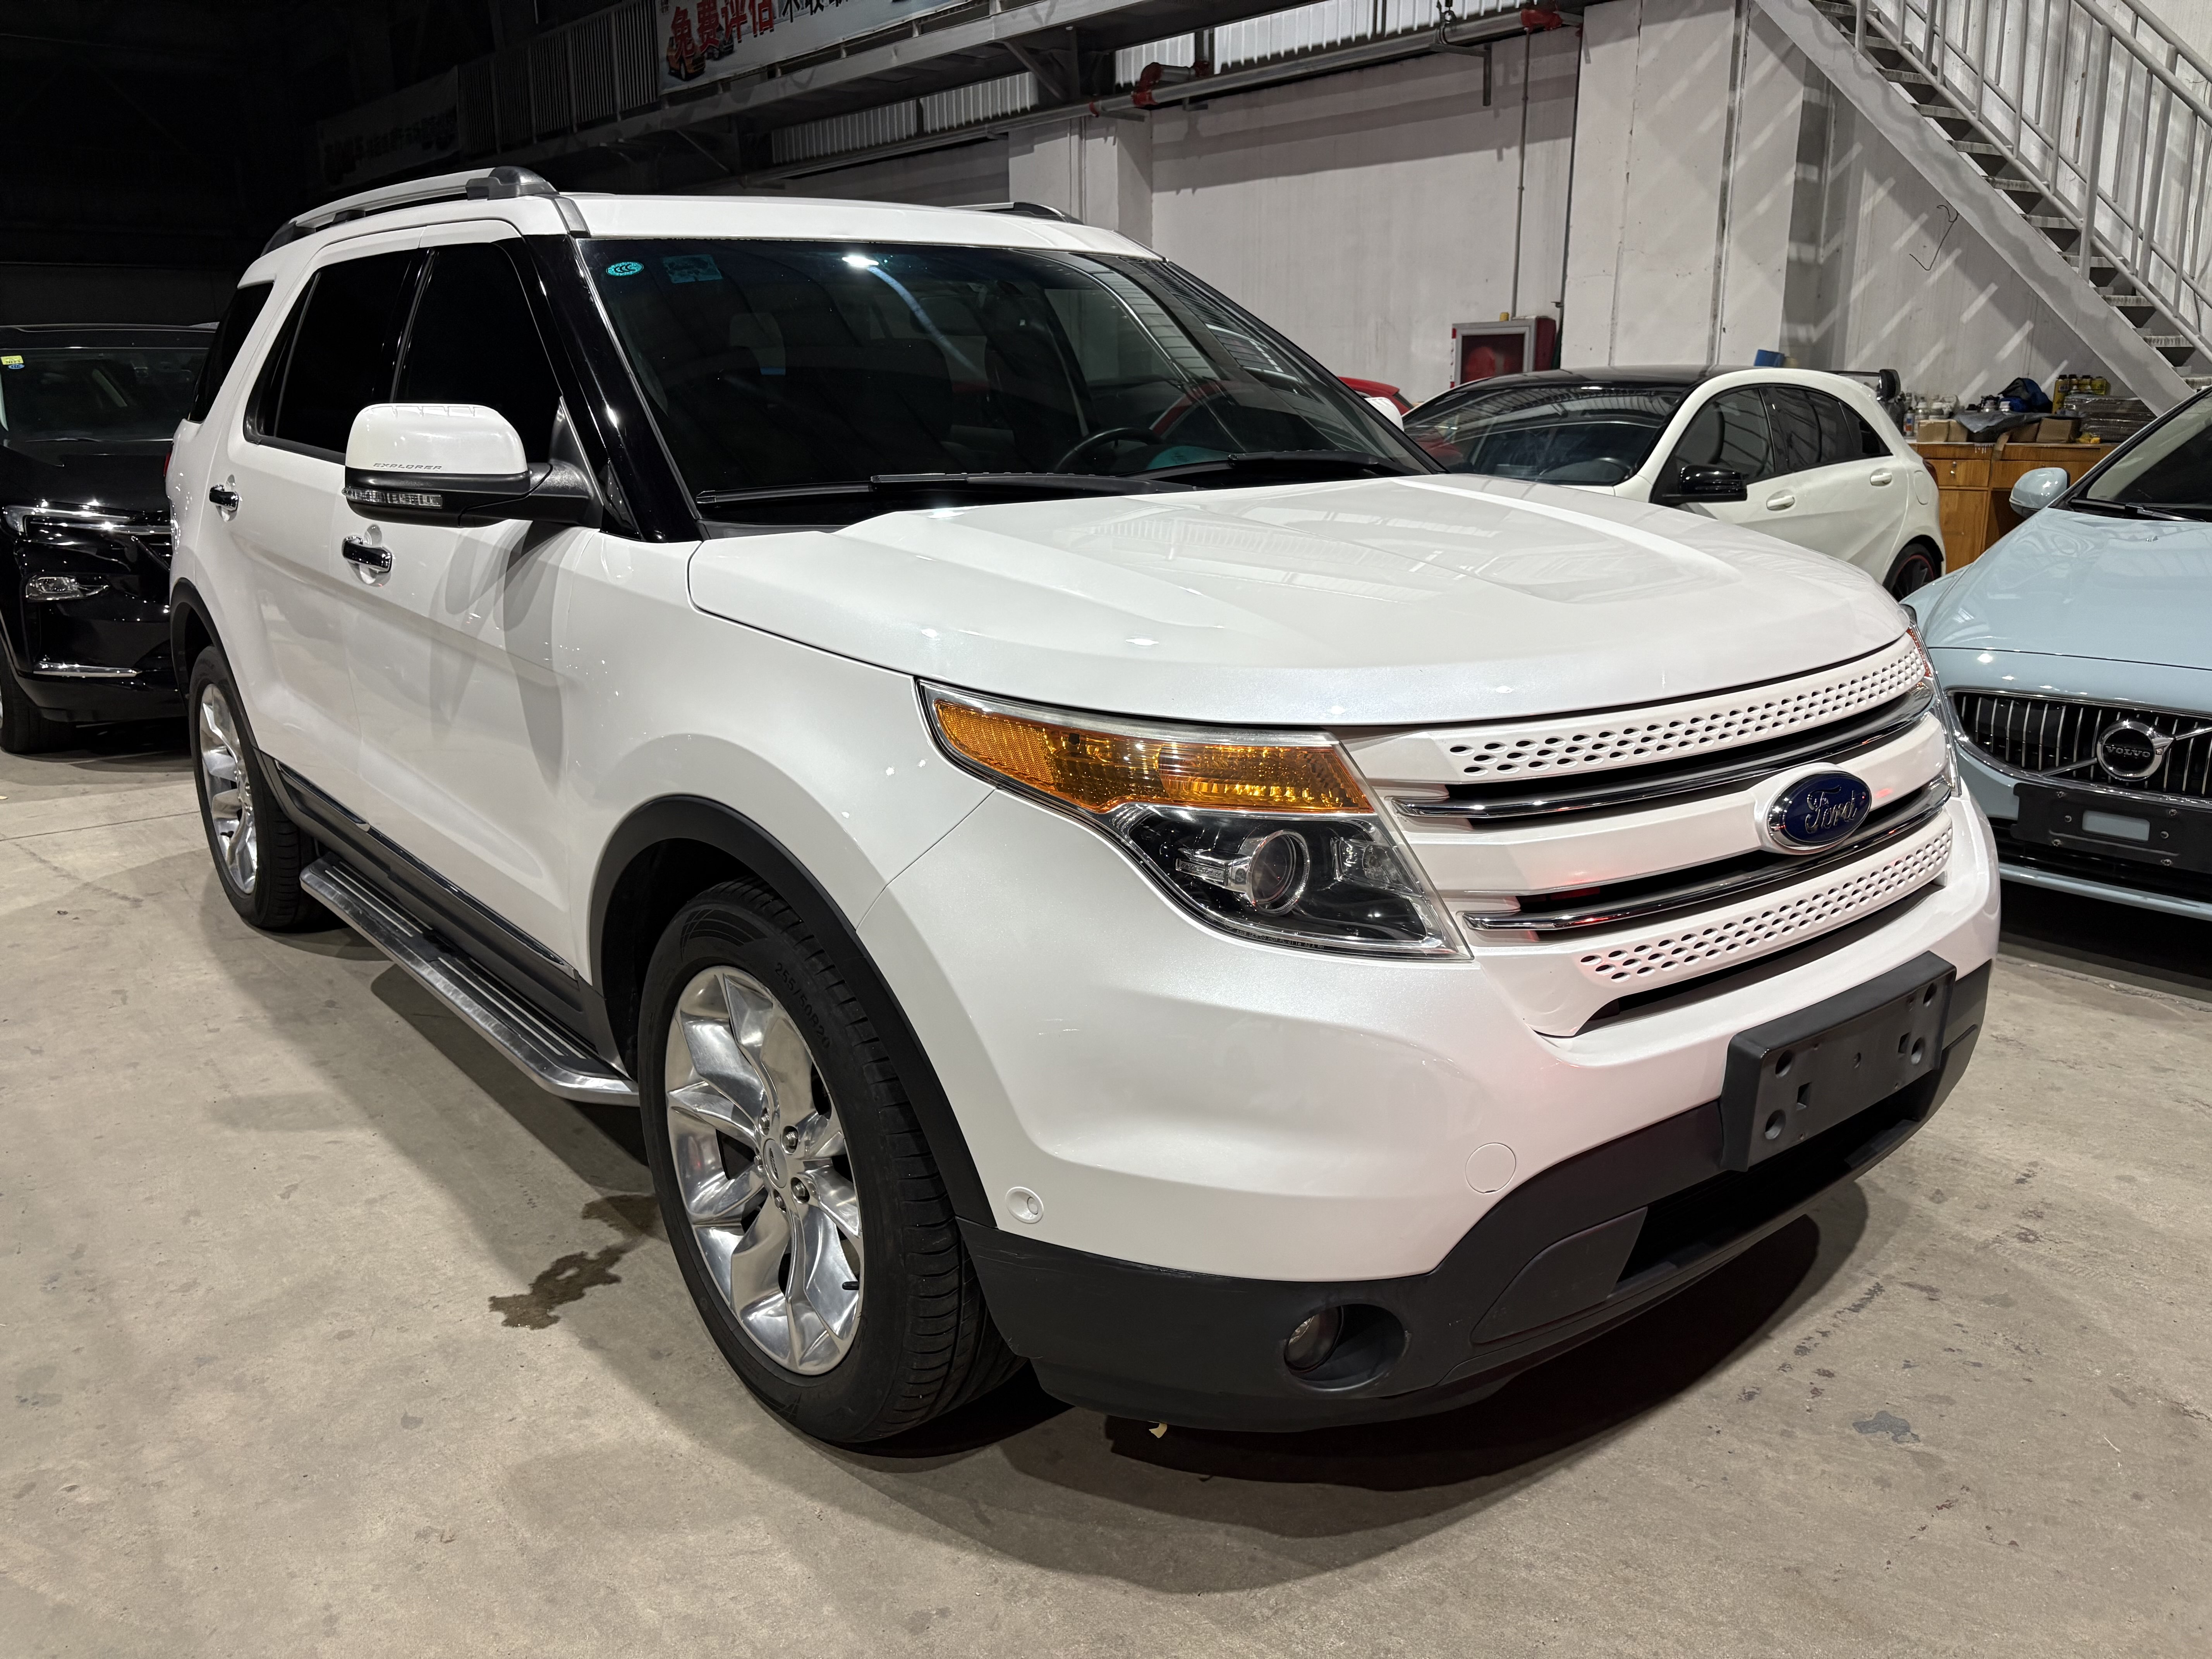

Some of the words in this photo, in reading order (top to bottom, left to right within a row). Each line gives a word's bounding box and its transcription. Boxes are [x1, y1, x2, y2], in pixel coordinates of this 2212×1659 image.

[2106, 745, 2150, 757] VOLVO
[1805, 785, 1858, 834] Ford
[775, 962, 830, 1049] 255/50R20
